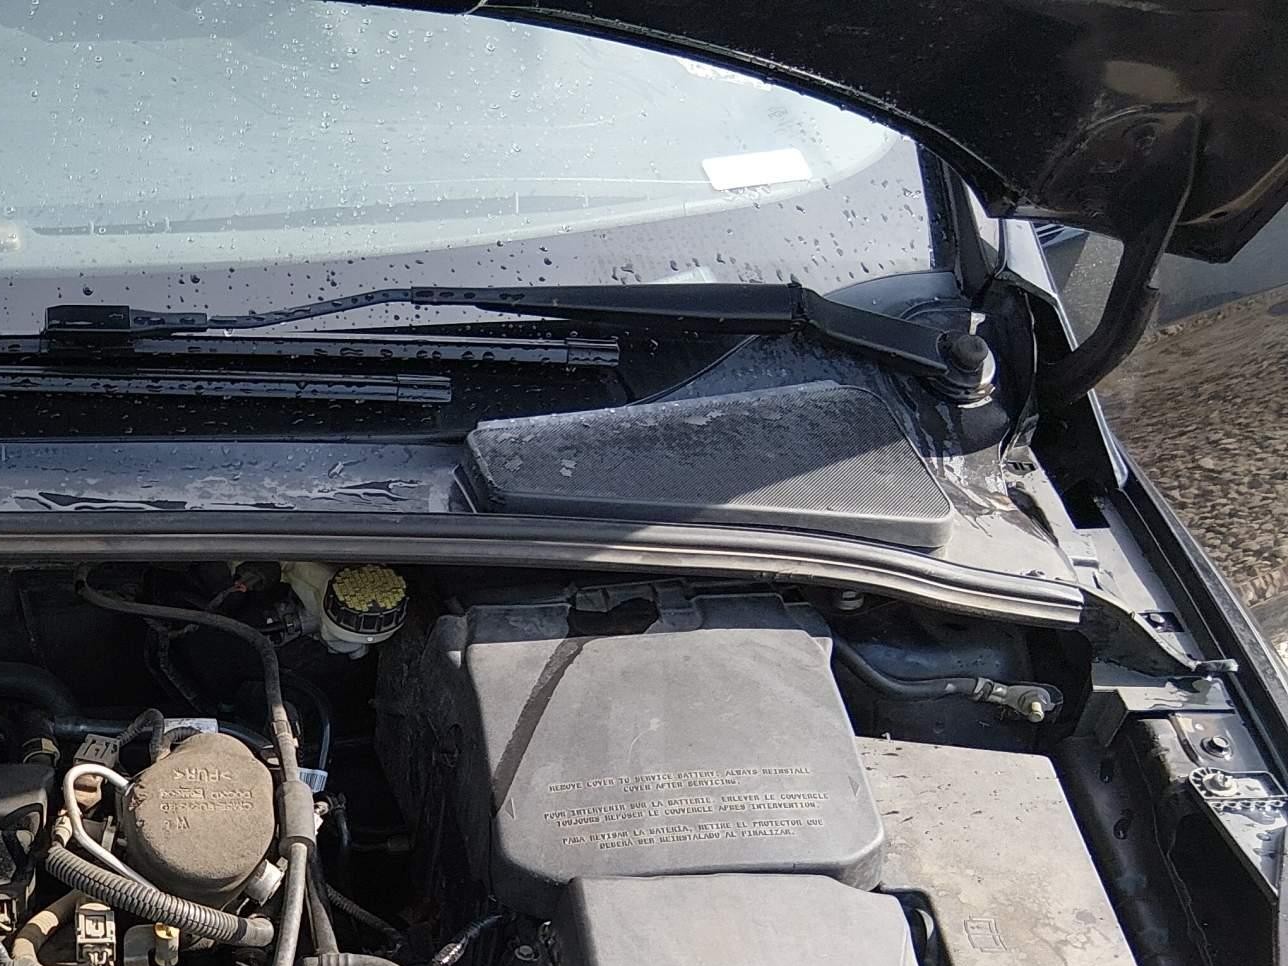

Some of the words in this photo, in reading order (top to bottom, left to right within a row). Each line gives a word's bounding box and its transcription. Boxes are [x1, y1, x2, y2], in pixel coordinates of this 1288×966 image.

[549, 782, 582, 792] REMOVE
[587, 778, 615, 787] COVER
[635, 774, 672, 783] SERVICE
[762, 767, 810, 775] REINSTALL
[623, 785, 651, 793] COVER
[656, 782, 682, 790] AFTER
[544, 812, 566, 820] POUR
[571, 804, 626, 817] INTERVENIR
[556, 817, 600, 828] TOUJOURS
[605, 813, 643, 821] REPOSER
[665, 806, 713, 815] COUVERCLE
[590, 832, 628, 841] REVISAR
[699, 822, 731, 830] RETIRE
[752, 819, 803, 827] PROTECTOR
[660, 832, 720, 843] REINSTALADO
